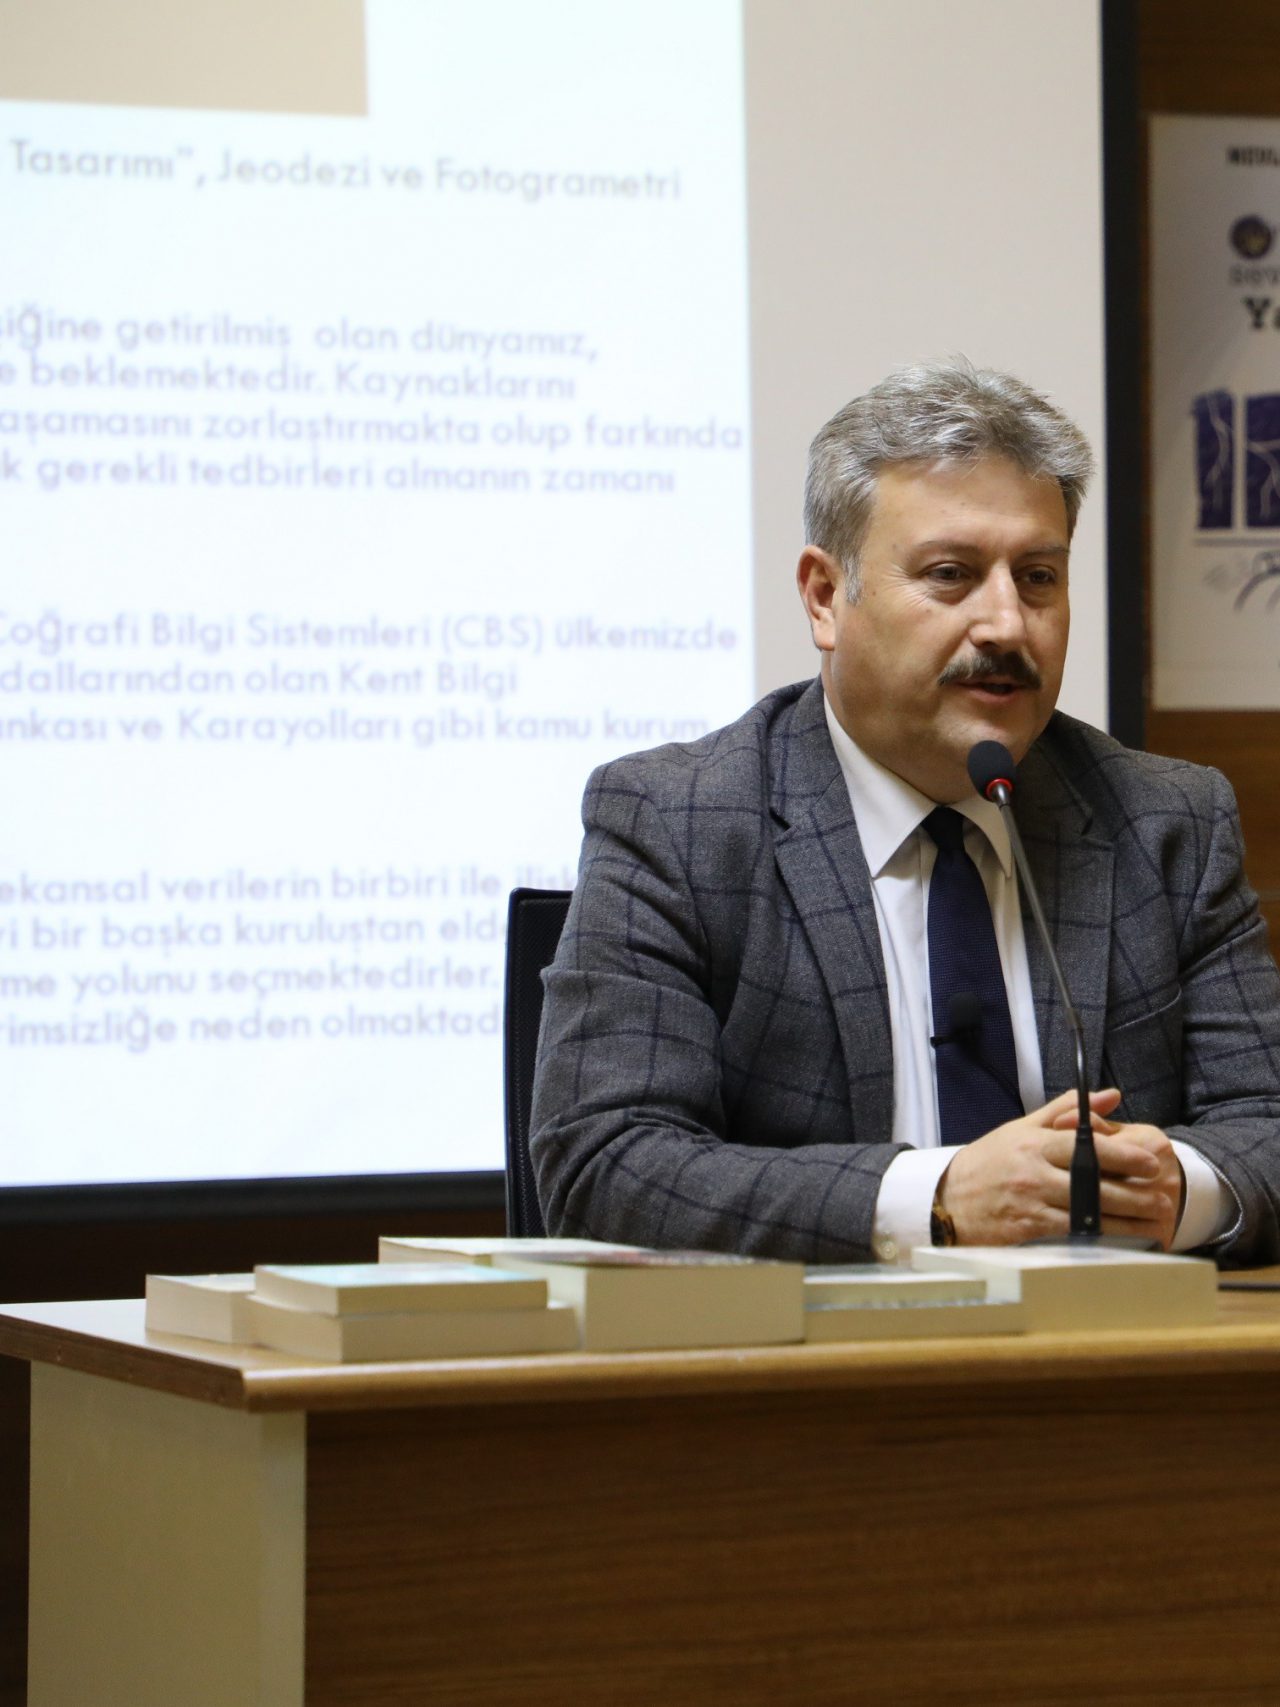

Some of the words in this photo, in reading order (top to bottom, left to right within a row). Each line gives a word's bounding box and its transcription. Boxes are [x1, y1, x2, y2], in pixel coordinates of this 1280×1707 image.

[219, 150, 370, 187] Jeodezi
[382, 168, 424, 189] ve
[436, 158, 680, 202] Fotogrametri
[0, 302, 103, 350] iğine
[315, 319, 398, 349] olan
[411, 321, 597, 363] dünyamız,
[336, 355, 575, 403] Kaynaklarını
[0, 410, 191, 445] aşamasını
[205, 408, 480, 447] zorlaştırmakta
[492, 415, 571, 452] olup
[586, 415, 742, 450] farkında
[36, 452, 177, 492] gerekli
[188, 454, 373, 488] tedbirleri
[384, 459, 530, 490] almanın
[544, 470, 674, 492] zamanı
[0, 610, 139, 657] oğrafi
[152, 613, 235, 655] Bilgi
[248, 614, 430, 647] Sistemleri
[442, 616, 542, 653] (CBS)
[556, 618, 737, 650] ülkemizde
[0, 661, 234, 694] dallarından
[244, 664, 329, 693] olan
[340, 664, 423, 694] Kent
[438, 664, 516, 701] Bilgi
[0, 709, 107, 741] nkası
[120, 719, 163, 740] ve
[179, 708, 400, 746] Karayolları
[412, 709, 485, 747] gibi
[496, 710, 592, 739] kamu
[160, 869, 320, 902] verilerin
[332, 867, 448, 898] birbiri
[461, 866, 501, 898] ile
[31, 916, 85, 950] bir
[101, 915, 222, 957] başka
[235, 912, 424, 953] kuruluştan
[439, 907, 508, 944] eld
[72, 963, 196, 1004] yolunu
[209, 957, 499, 1002] seçmektedirler.
[0, 1011, 177, 1055] imsizliğe
[190, 1010, 311, 1041] neden
